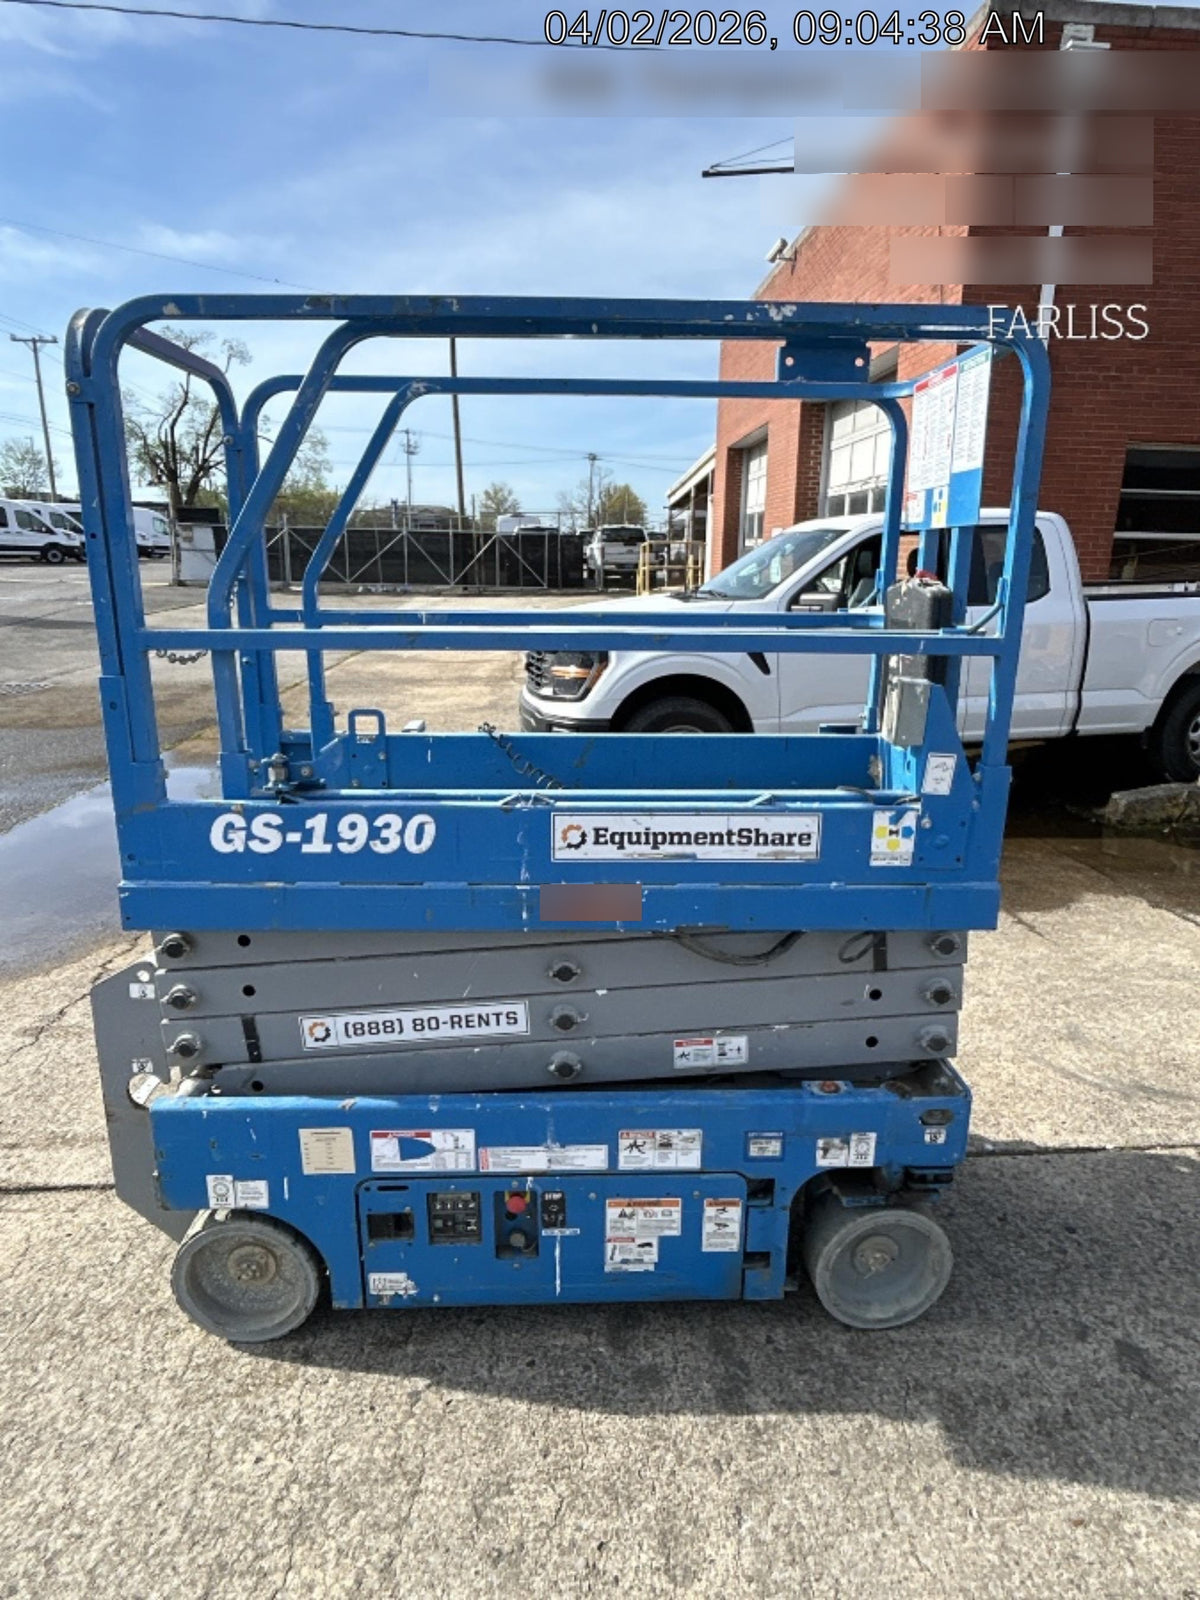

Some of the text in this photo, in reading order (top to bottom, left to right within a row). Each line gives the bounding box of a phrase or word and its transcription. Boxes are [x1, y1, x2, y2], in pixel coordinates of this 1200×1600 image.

[210, 814, 437, 854] GS-1930
[592, 827, 812, 851] EquipmentShare
[345, 1010, 519, 1038] (888) 80-RENTS
